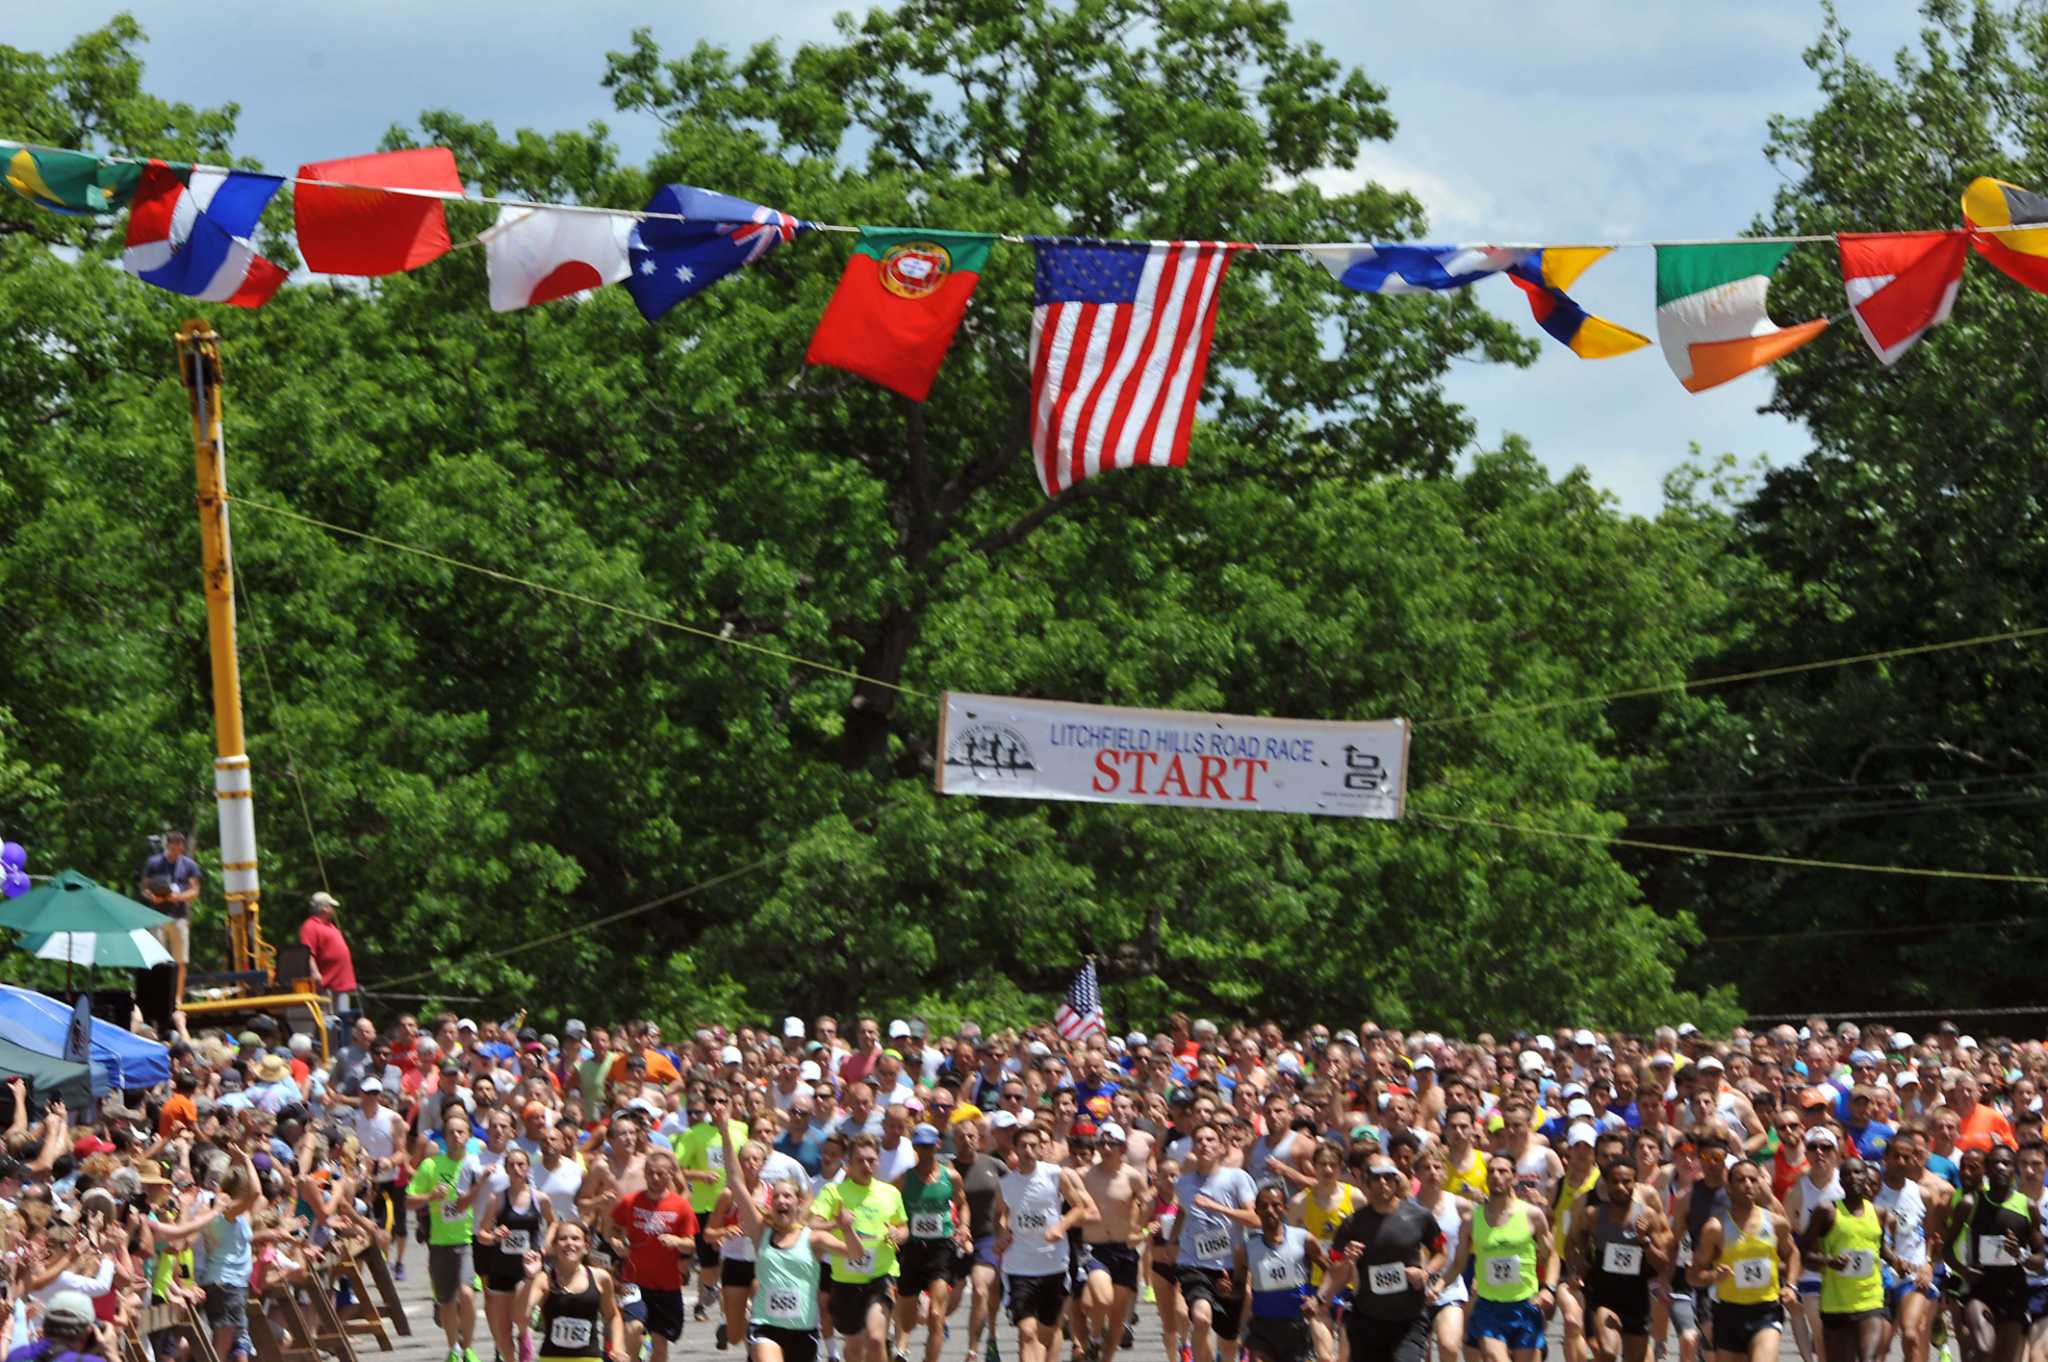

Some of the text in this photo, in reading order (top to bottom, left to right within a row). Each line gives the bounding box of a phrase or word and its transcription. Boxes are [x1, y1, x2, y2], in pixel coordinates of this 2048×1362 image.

[1050, 723, 1151, 751] LITCHFIELD
[1156, 729, 1204, 753] HILLS
[1210, 733, 1260, 758] ROAD
[1260, 737, 1315, 763] RACE
[1092, 748, 1269, 802] START
